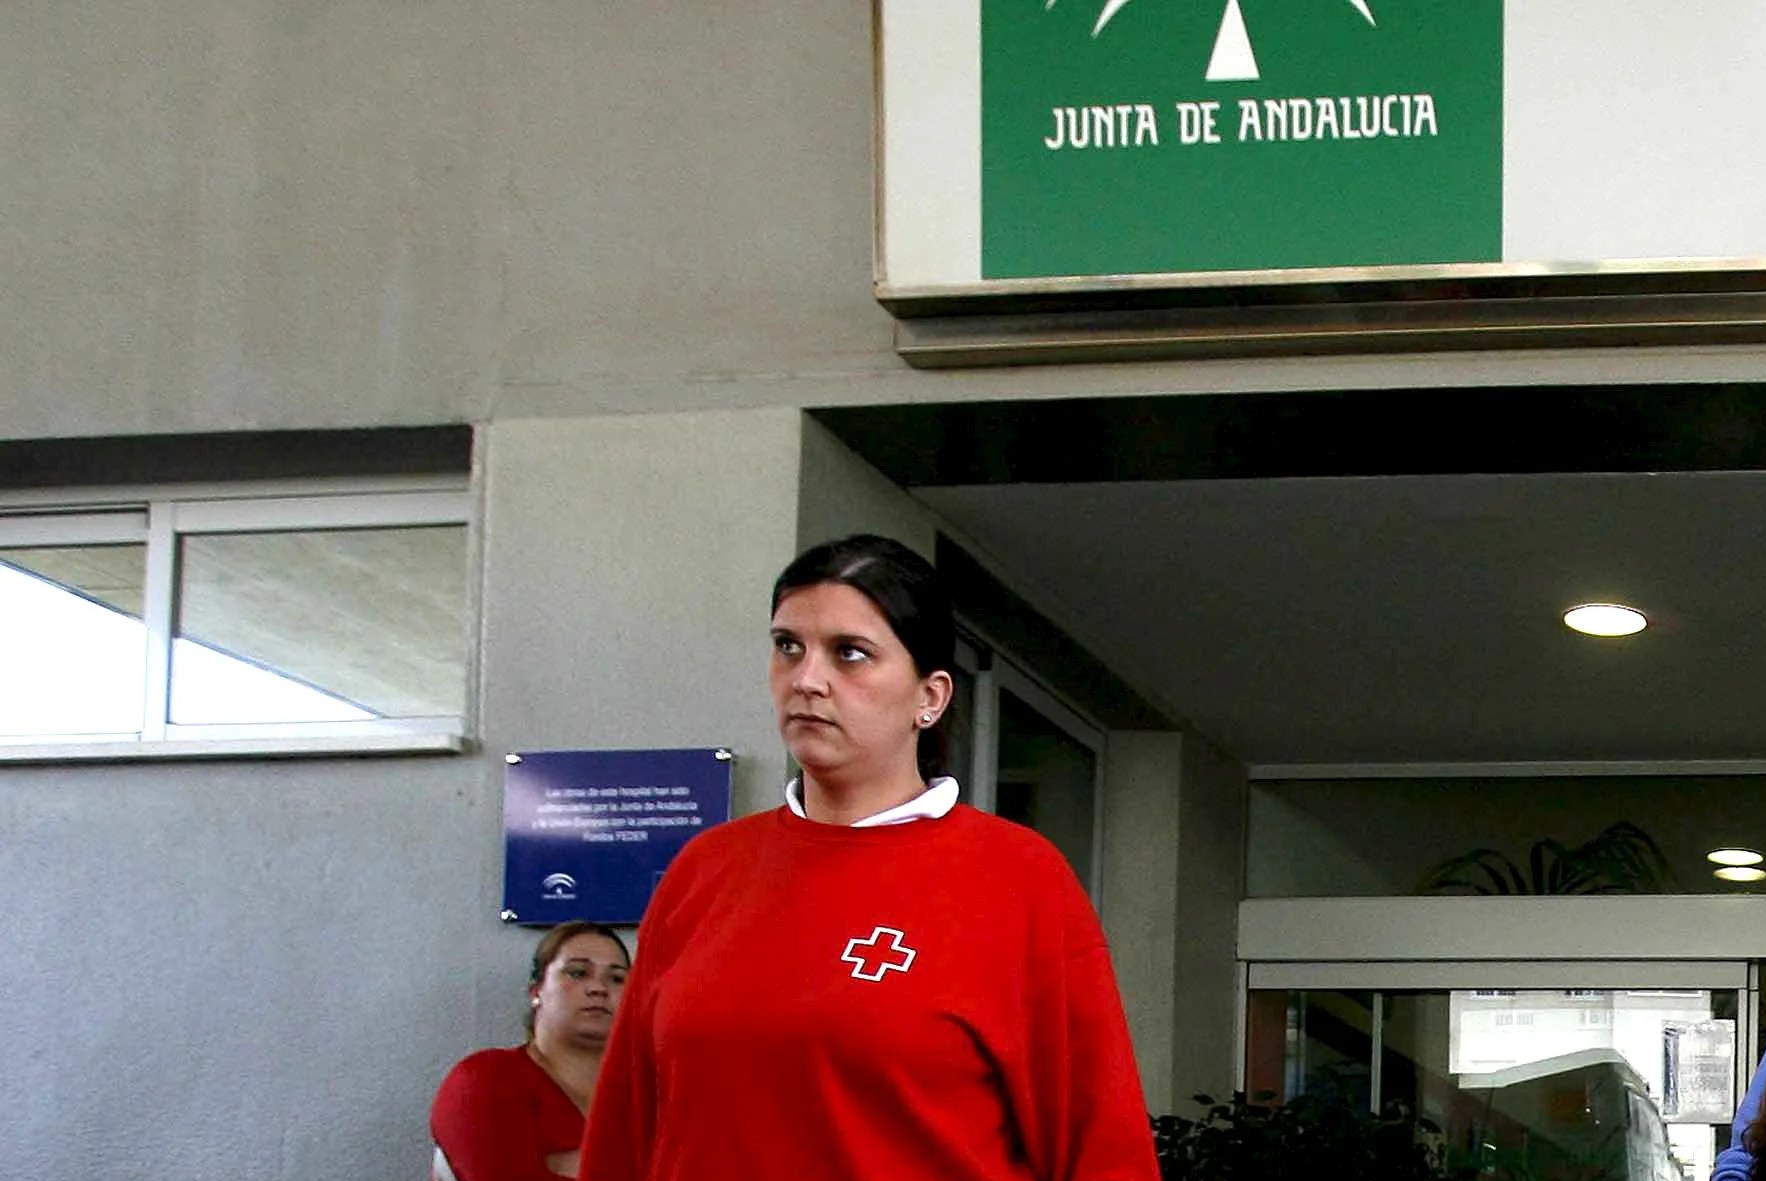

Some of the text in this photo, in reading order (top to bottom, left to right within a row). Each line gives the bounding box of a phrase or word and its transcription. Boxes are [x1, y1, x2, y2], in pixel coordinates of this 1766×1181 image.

[1044, 95, 1438, 150] JUNTA DE ANDALUCIA
